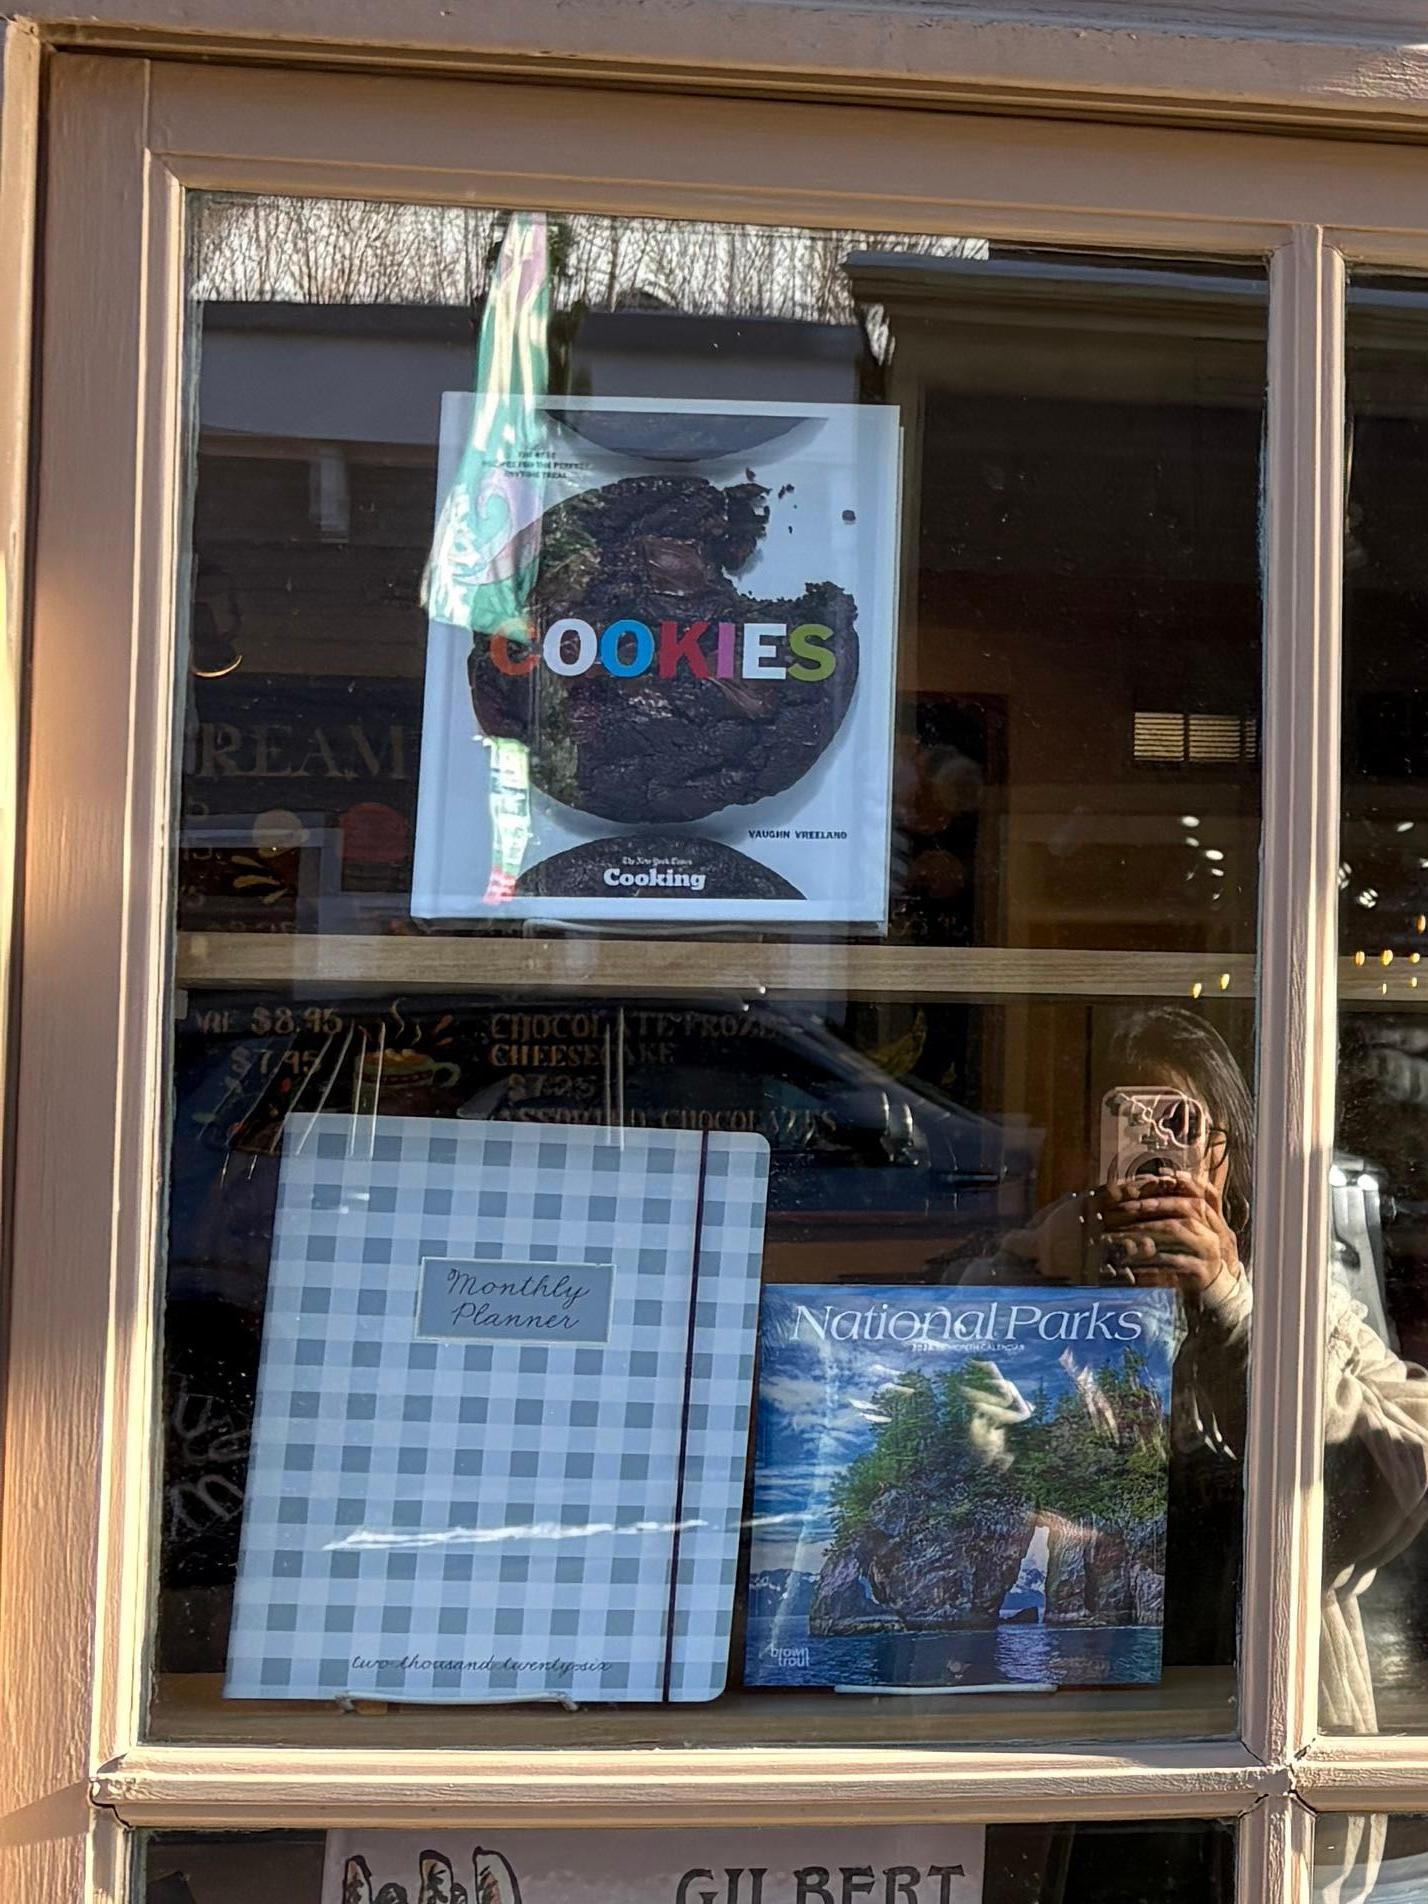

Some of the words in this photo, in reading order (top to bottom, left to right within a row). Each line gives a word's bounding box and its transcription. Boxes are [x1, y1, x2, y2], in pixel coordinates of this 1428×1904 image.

[489, 617, 837, 682] COOKIES
[748, 829, 790, 840] VAUGHN
[795, 830, 848, 840] VREELAND
[603, 867, 706, 891] Cooking
[447, 1268, 592, 1309] Monthly
[451, 1302, 581, 1330] Planner
[789, 1301, 999, 1342] National
[1005, 1301, 1145, 1342] Parks
[352, 1656, 391, 1670] two
[395, 1653, 497, 1671] thousand
[770, 1644, 810, 1658] brown
[778, 1655, 810, 1667] trout
